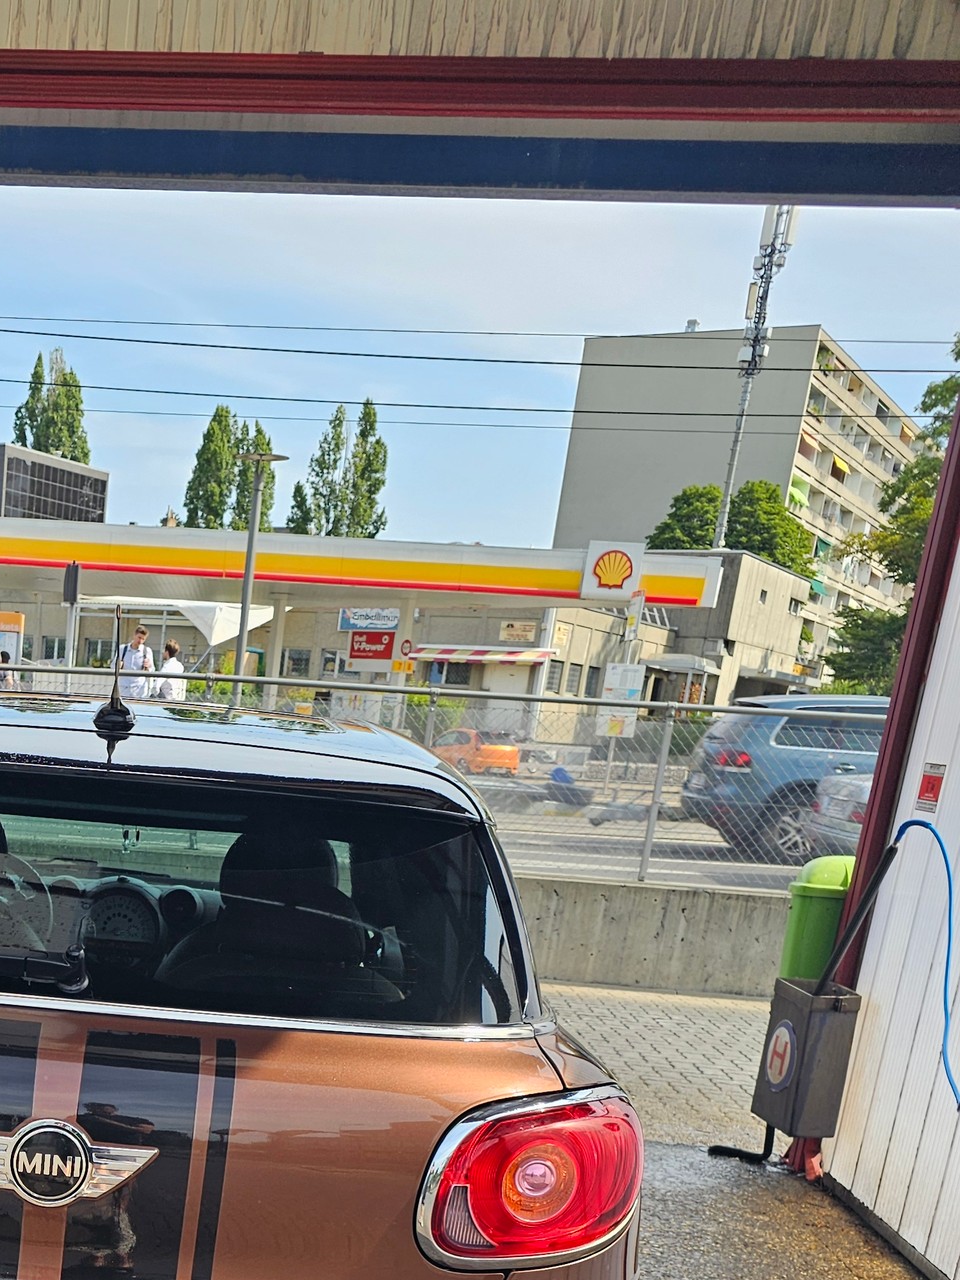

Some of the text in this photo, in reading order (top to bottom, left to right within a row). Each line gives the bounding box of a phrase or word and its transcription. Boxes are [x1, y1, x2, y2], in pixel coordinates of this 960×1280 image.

[353, 641, 386, 651] V-Power
[768, 1034, 789, 1077] H
[18, 1151, 81, 1178] MINI
